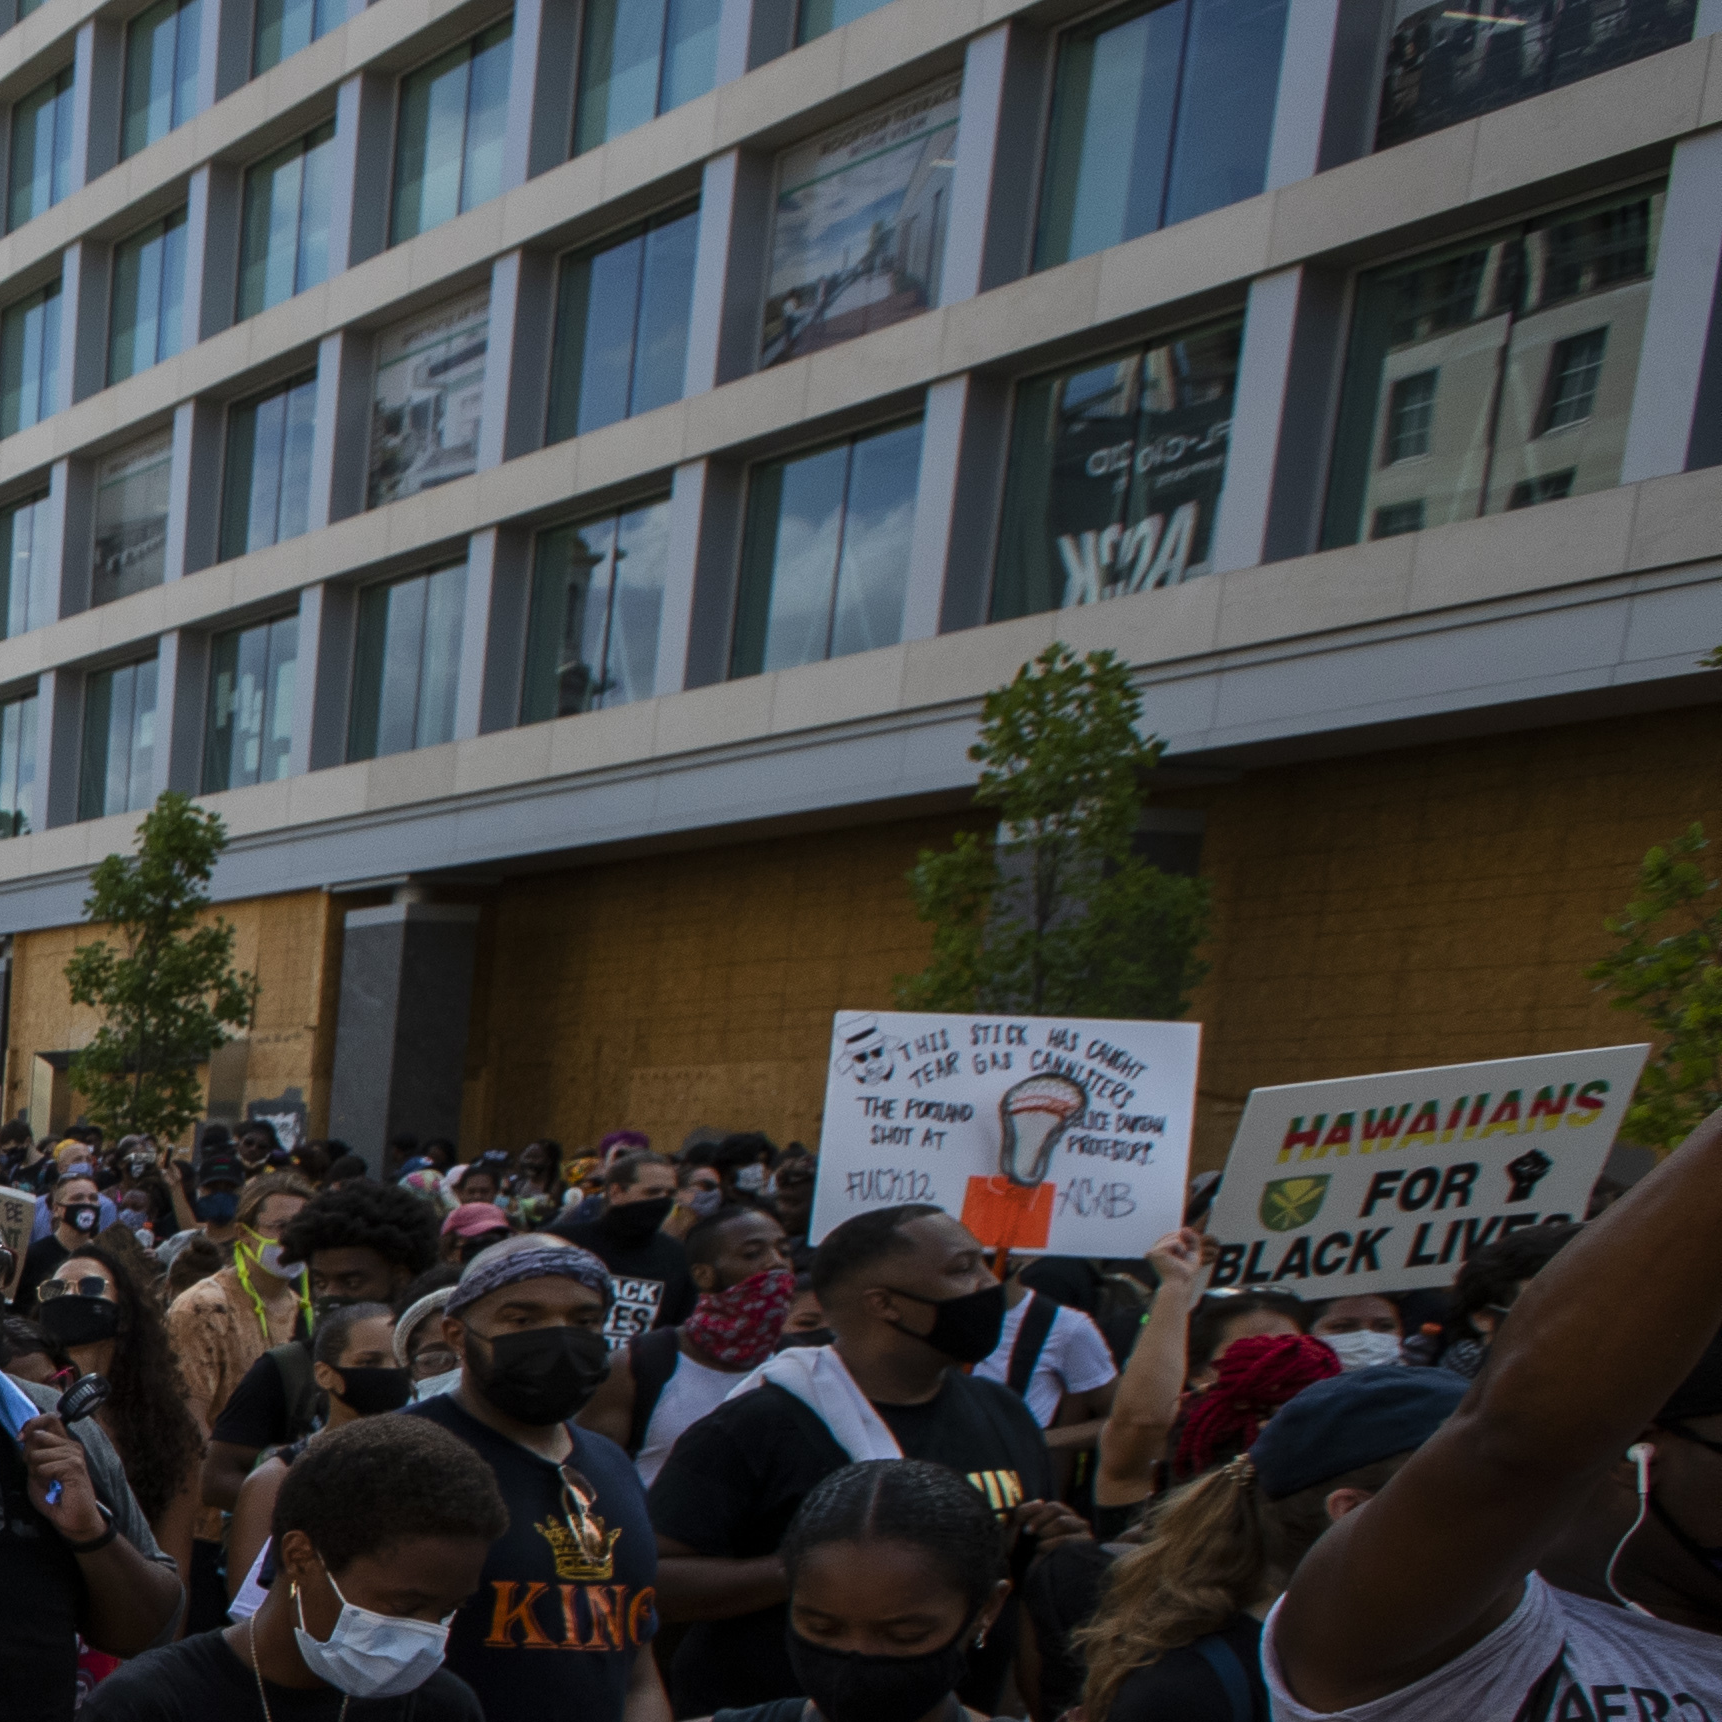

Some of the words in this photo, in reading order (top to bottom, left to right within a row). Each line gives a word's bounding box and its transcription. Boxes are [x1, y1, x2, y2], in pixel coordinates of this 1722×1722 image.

[898, 1028, 951, 1063] THIS
[969, 1023, 1030, 1047] STICK
[1045, 1027, 1080, 1053] HAS
[1084, 1039, 1150, 1080] CAUGHT
[908, 1051, 961, 1089] TEAR
[972, 1051, 1014, 1075] GAS
[859, 1096, 896, 1121] THE
[1067, 1106, 1111, 1132] LICE
[1277, 1079, 1612, 1165] HAWAIIANS
[869, 1124, 913, 1147] SHOT
[921, 1129, 949, 1151] AT
[1055, 1176, 1138, 1220] ACAB
[1358, 1161, 1482, 1218] FOR
[5, 1201, 24, 1224] BE
[1208, 1226, 1394, 1288] BLACK
